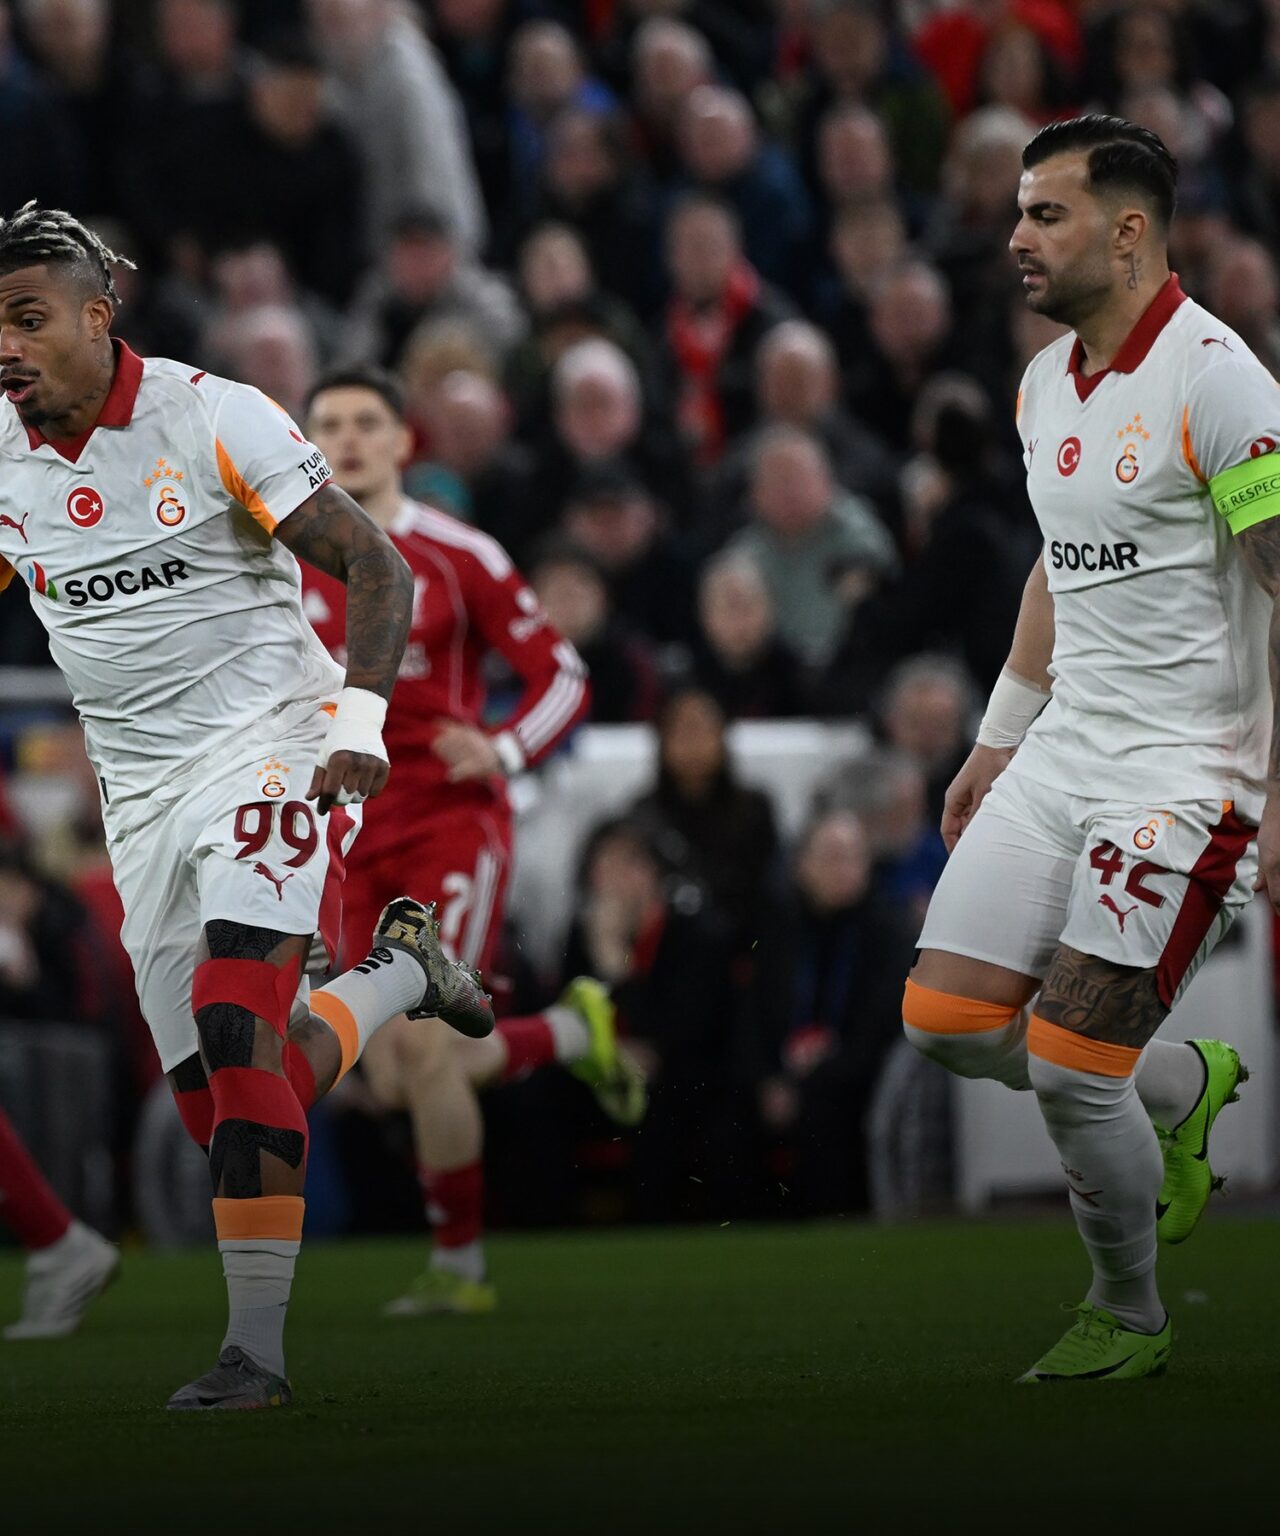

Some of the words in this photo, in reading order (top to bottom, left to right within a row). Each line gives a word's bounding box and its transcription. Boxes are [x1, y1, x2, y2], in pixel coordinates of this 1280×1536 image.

[1230, 477, 1280, 507] RESPEC
[1050, 540, 1141, 572] SOCAR
[64, 559, 190, 607] SOCAR
[233, 800, 320, 869] 99
[1089, 840, 1169, 909] 42
